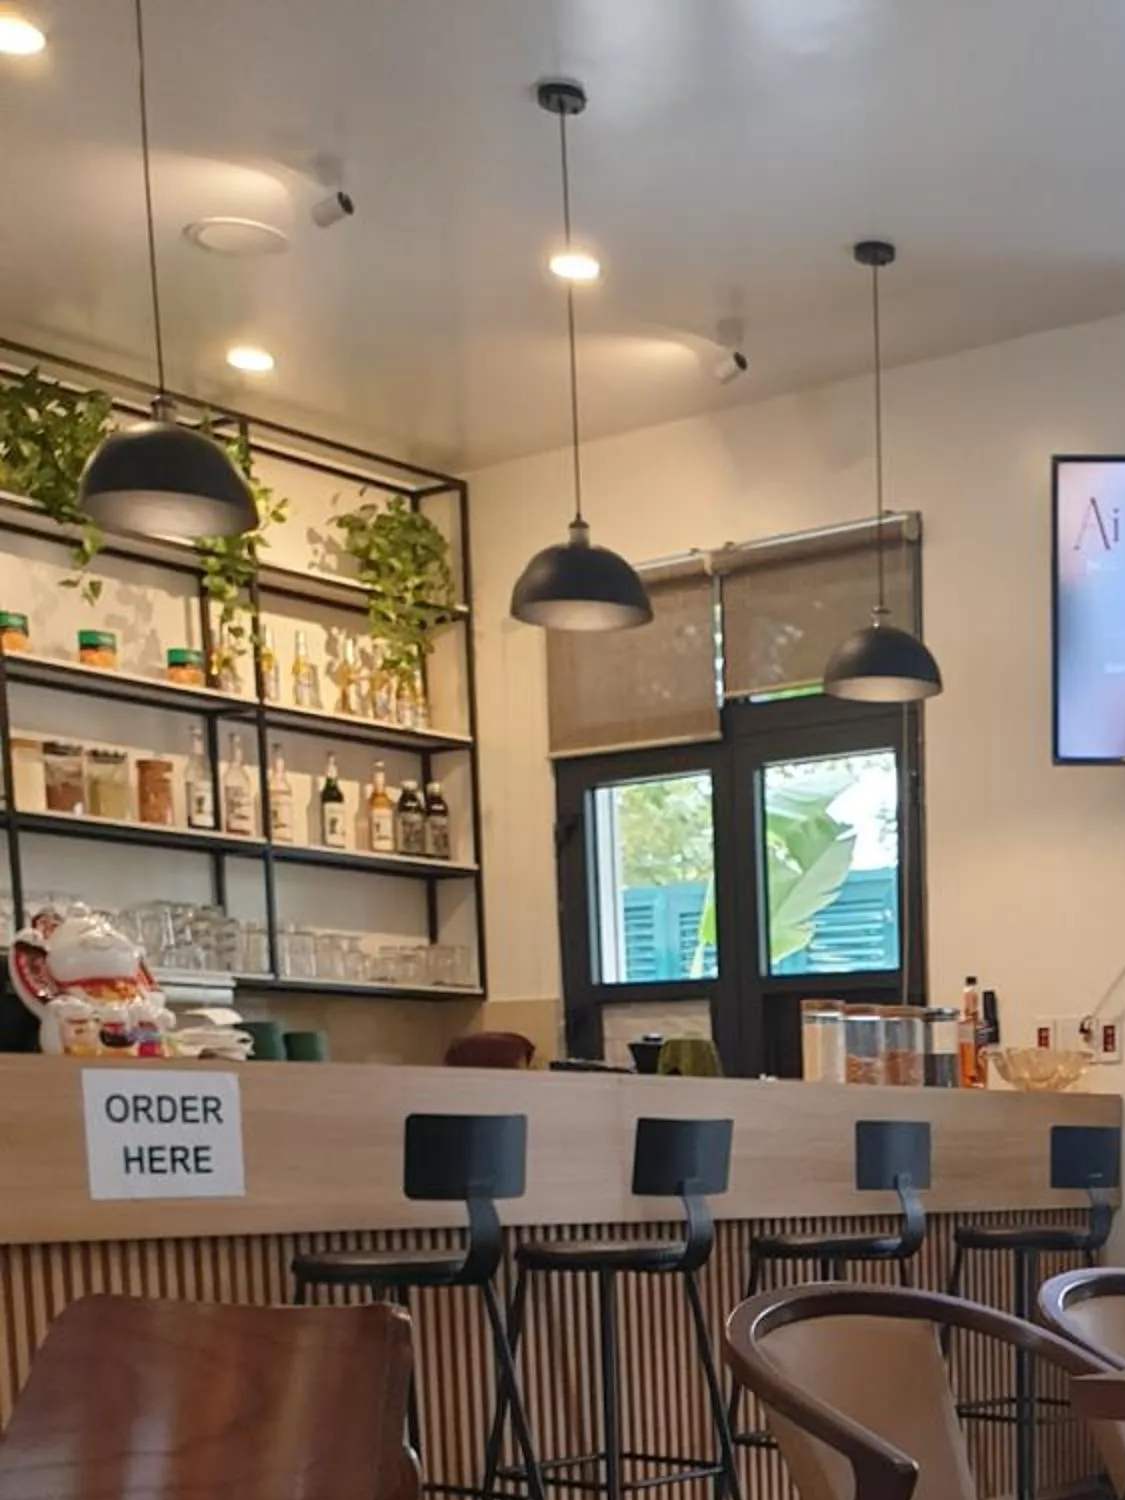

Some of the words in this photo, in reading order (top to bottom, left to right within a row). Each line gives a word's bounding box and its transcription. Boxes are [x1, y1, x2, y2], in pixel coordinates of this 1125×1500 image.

[1073, 496, 1120, 550] Ai
[105, 1094, 223, 1125] ORDER
[123, 1146, 214, 1175] HERE
